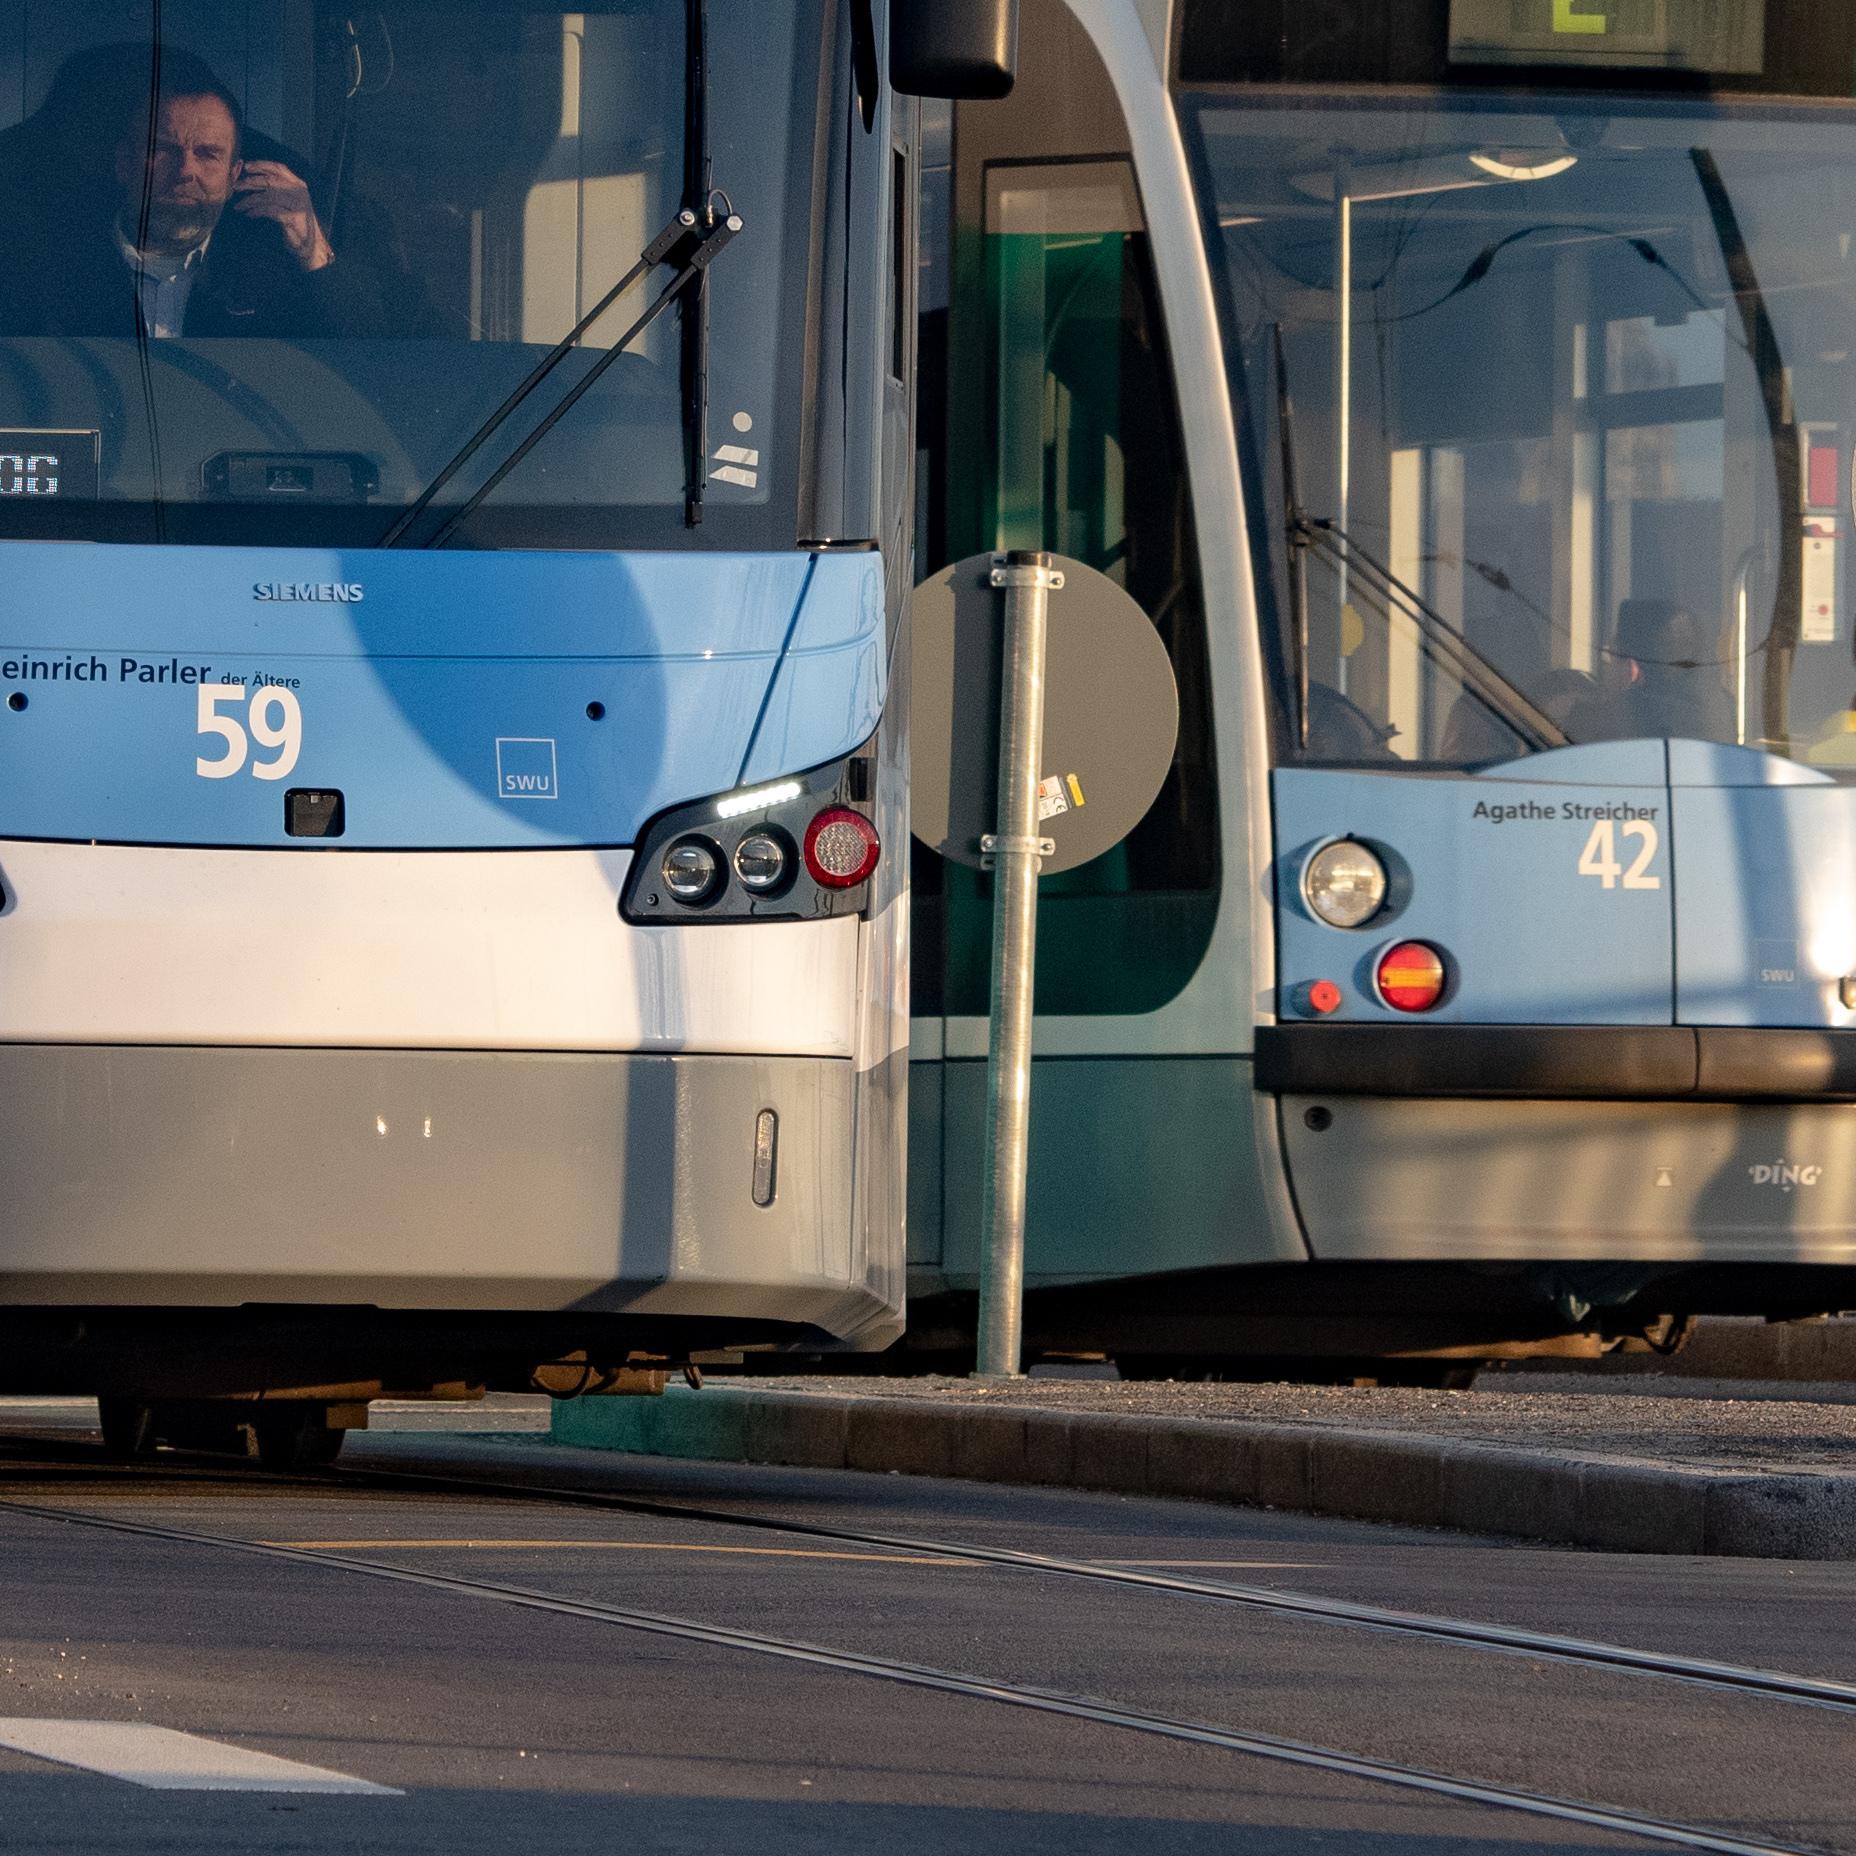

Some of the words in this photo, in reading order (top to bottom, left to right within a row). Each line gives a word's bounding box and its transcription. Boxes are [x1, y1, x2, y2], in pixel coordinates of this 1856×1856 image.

[253, 582, 364, 603] SIEMENS
[119, 658, 212, 685] Parler
[221, 671, 248, 687] der
[252, 670, 302, 689] Ältere
[196, 683, 303, 781] 59
[505, 775, 549, 791] SWU
[1472, 800, 1556, 824] Agathe
[1562, 801, 1659, 821] Streicher
[1578, 819, 1661, 889] 42
